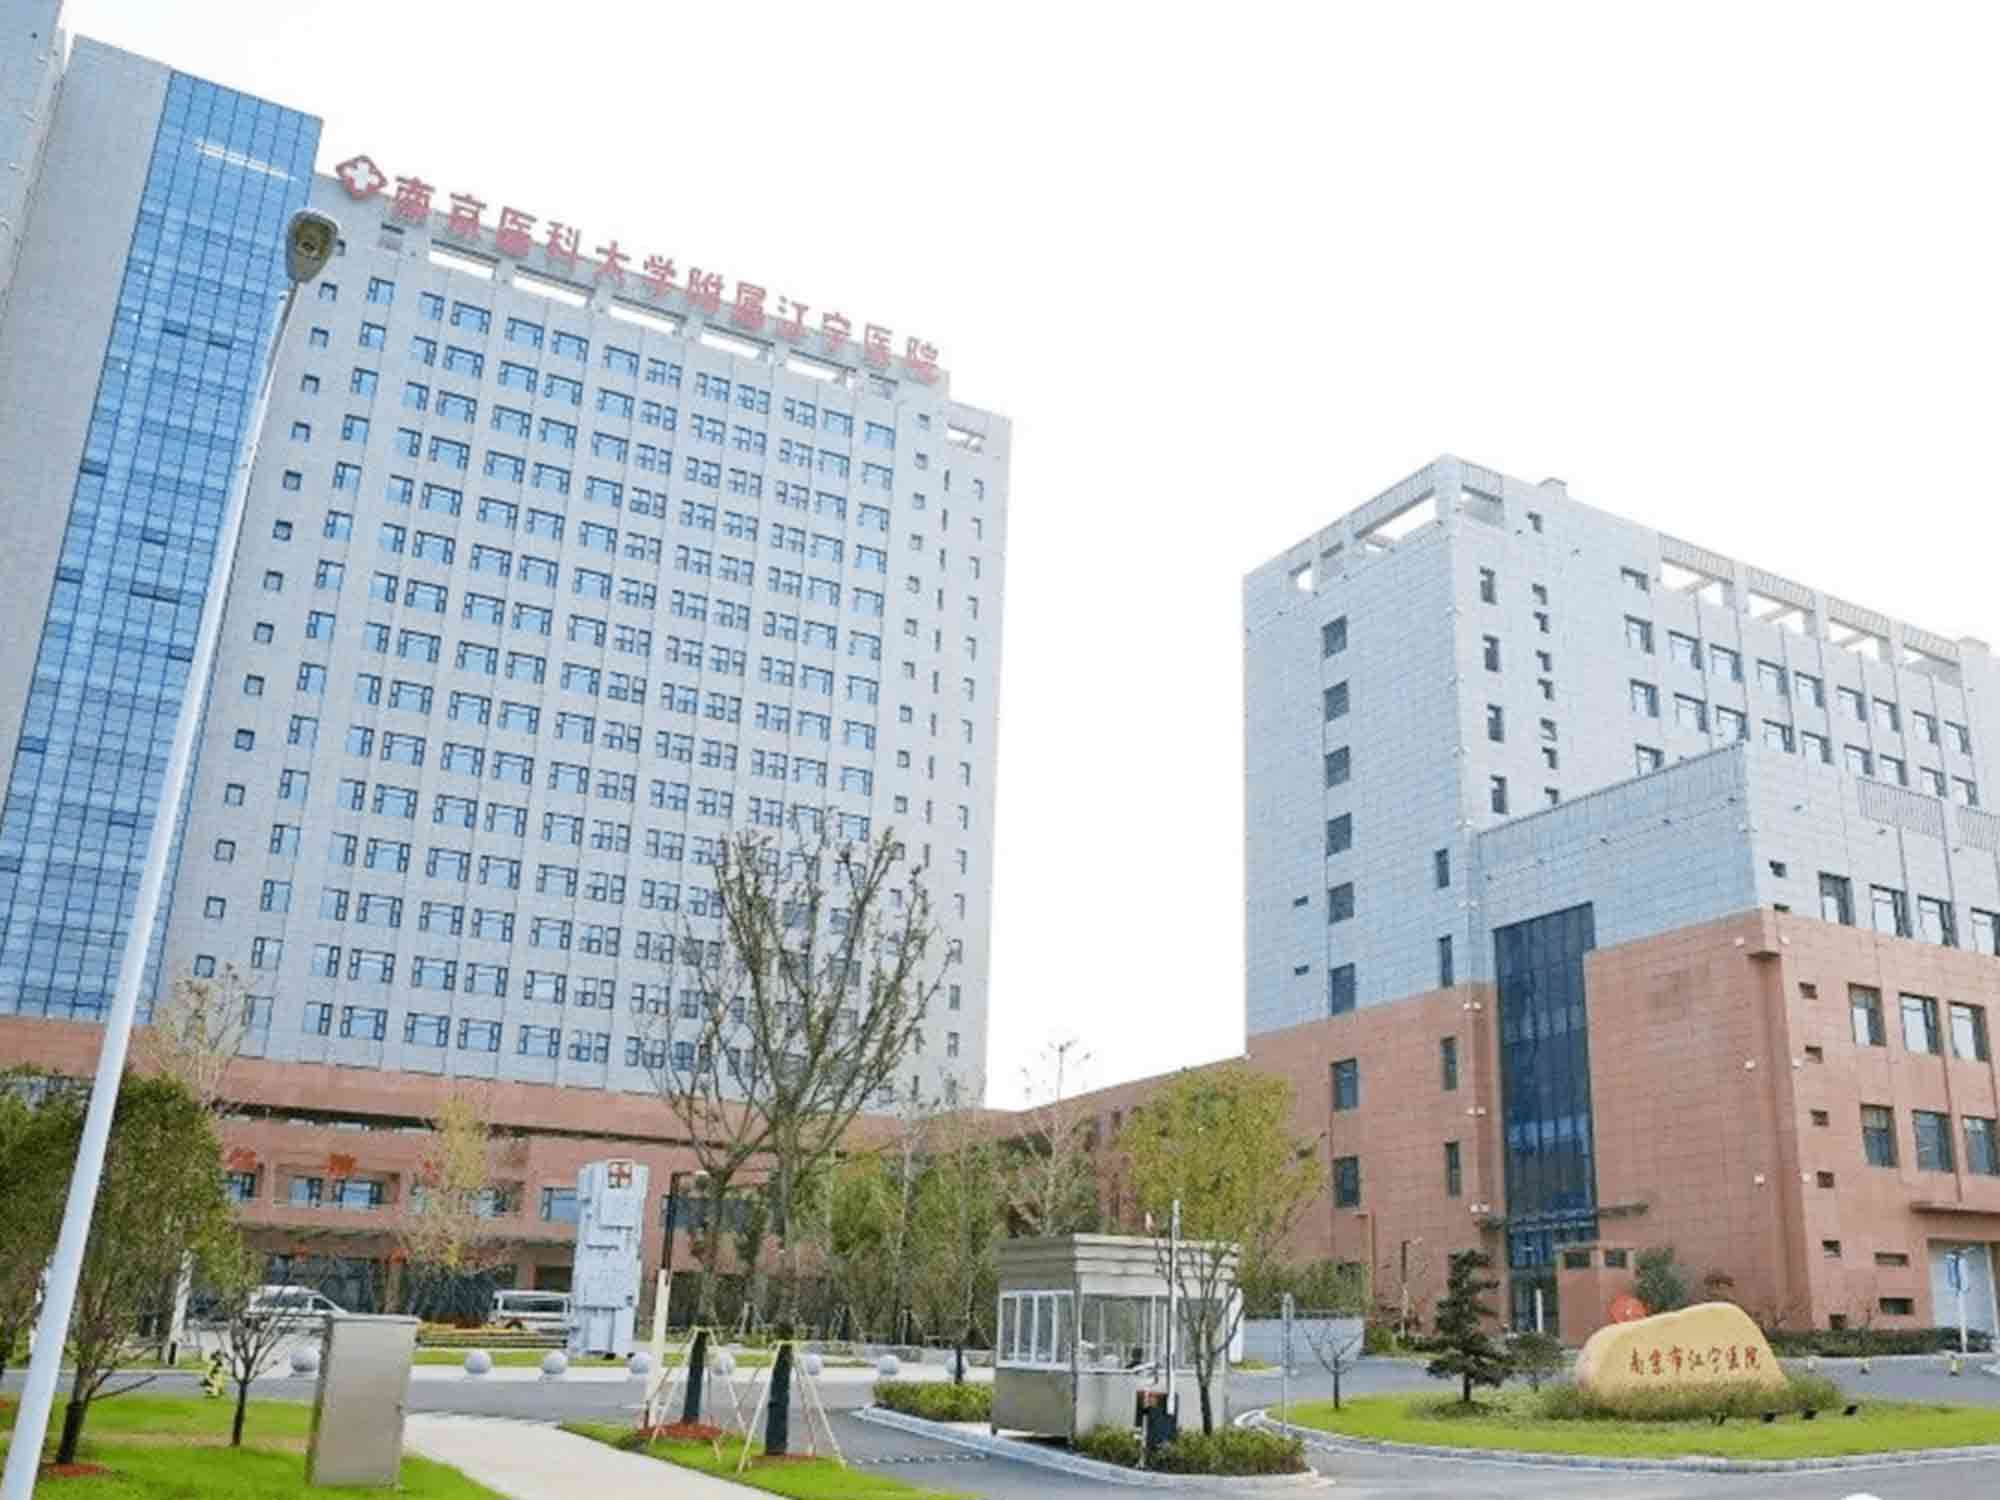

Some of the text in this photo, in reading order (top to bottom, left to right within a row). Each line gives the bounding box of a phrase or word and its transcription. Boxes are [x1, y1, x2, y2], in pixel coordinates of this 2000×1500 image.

[390, 176, 939, 384] 南京医科大学附属江宁医院
